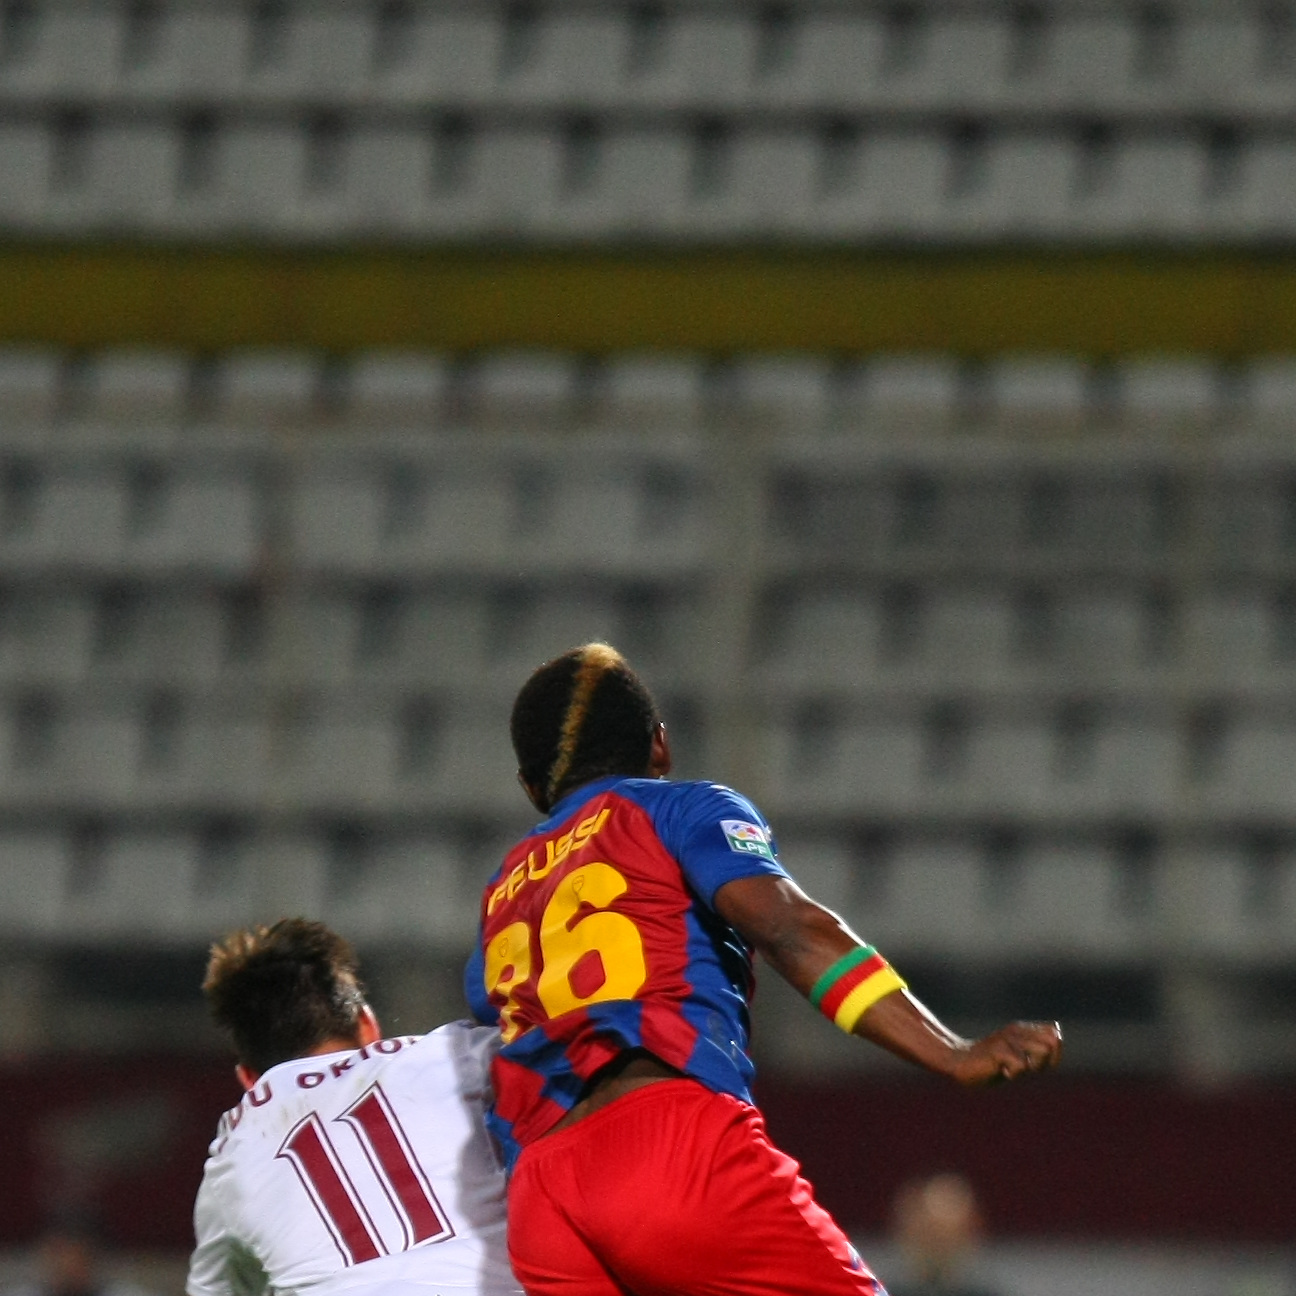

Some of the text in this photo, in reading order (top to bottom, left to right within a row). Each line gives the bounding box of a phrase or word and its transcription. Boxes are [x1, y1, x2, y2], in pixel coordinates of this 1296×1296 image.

[733, 840, 768, 855] LPF
[296, 1037, 417, 1089] OIO
[274, 1080, 456, 1267] 11
